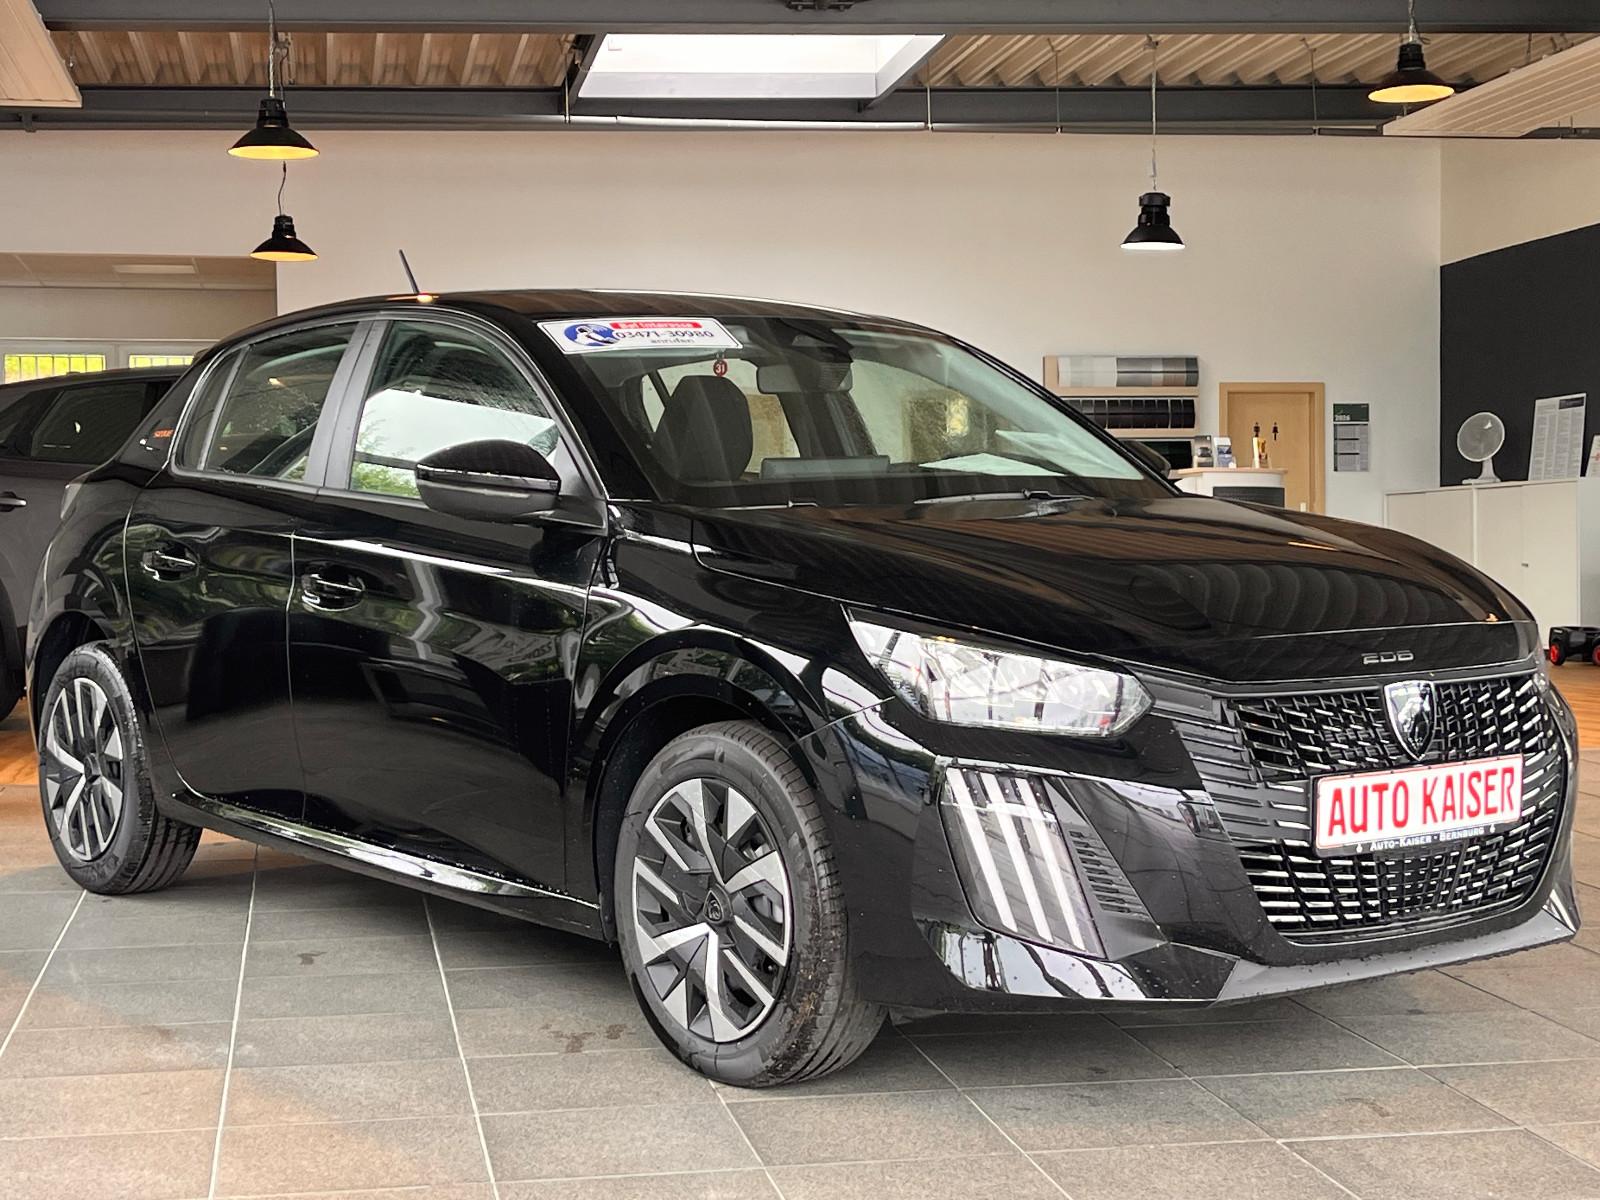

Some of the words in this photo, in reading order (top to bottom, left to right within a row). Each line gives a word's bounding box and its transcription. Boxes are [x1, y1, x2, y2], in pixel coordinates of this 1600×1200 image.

[615, 330, 713, 339] 03471-30980
[1327, 779, 1410, 837] AUTO
[1422, 766, 1515, 825] KAISER
